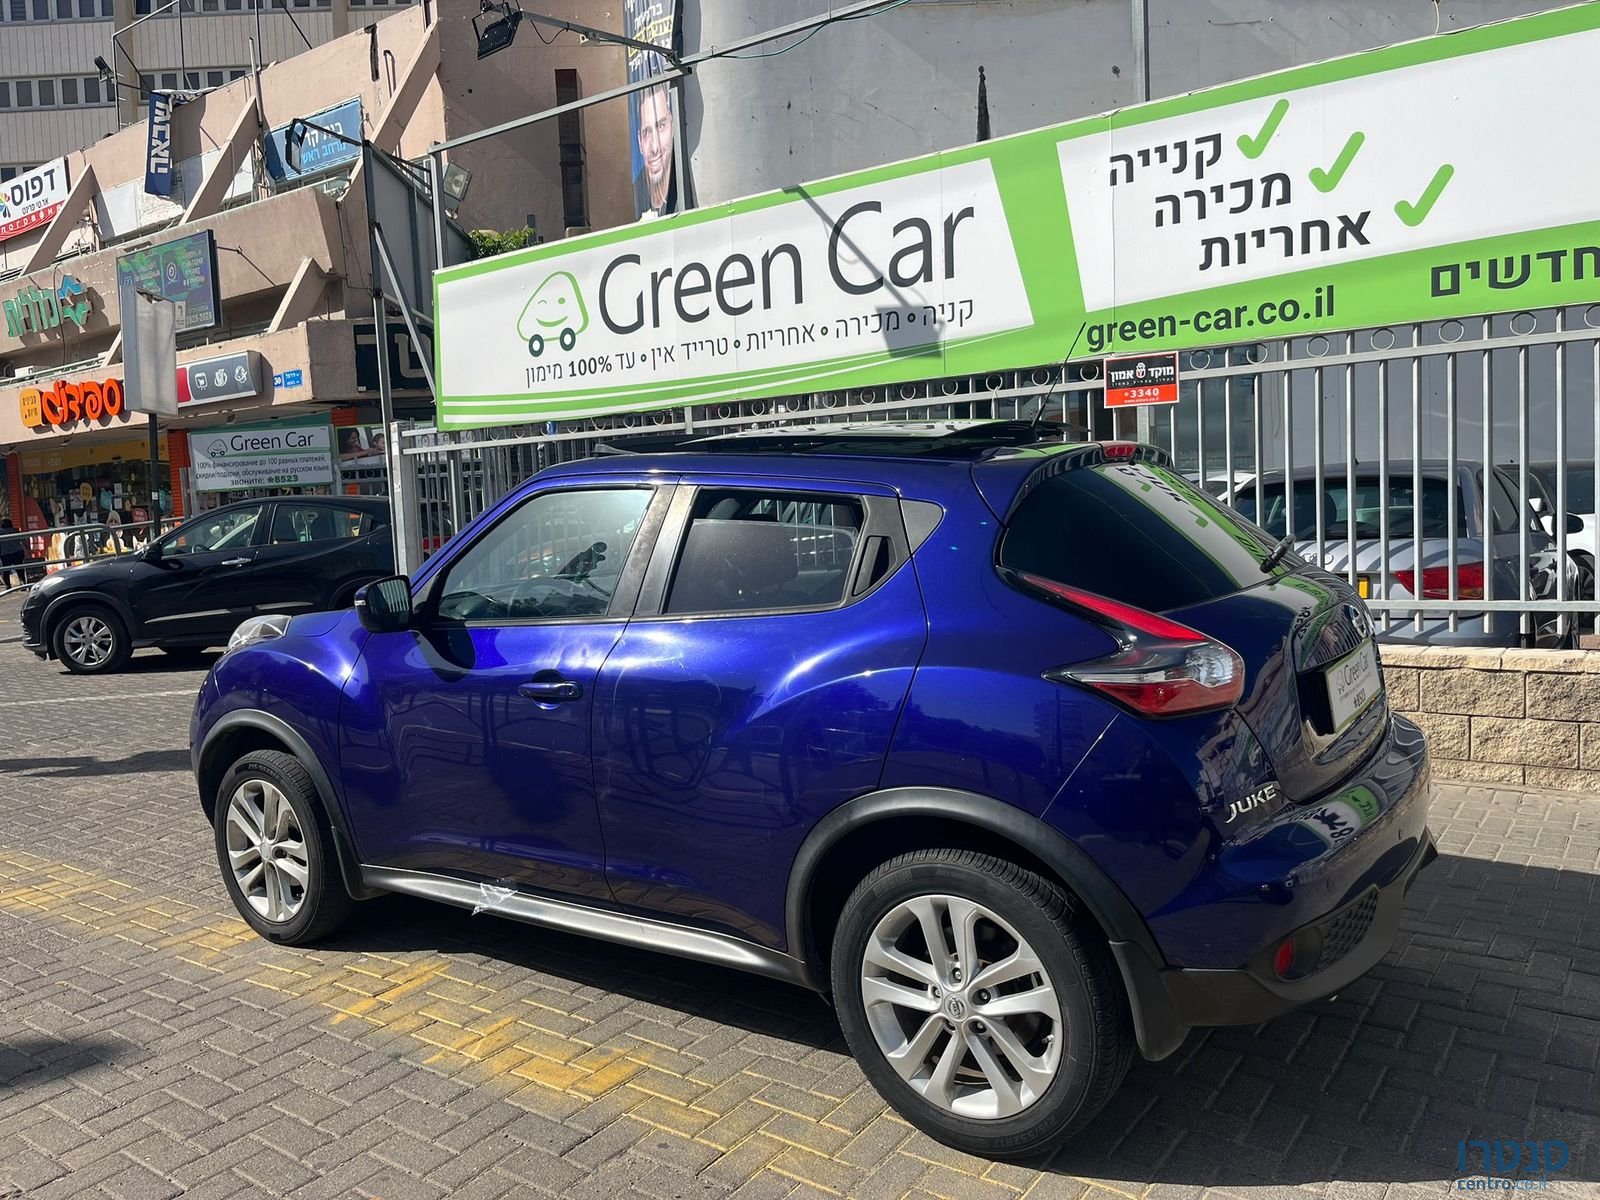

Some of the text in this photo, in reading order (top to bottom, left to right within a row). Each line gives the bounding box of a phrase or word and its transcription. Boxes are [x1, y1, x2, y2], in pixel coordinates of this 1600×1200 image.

[10, 168, 55, 206] דפוס
[1109, 133, 1222, 187] קנייה
[1155, 172, 1291, 228] מכירה
[1199, 210, 1371, 271] אחריות
[598, 200, 975, 336] Green Car
[525, 299, 974, 389] קניה מכירה אחריות טרייד אין עד 100% מימון
[1086, 285, 1335, 352] green-car.co.il
[1110, 366, 1175, 383] מוקד אמון
[230, 431, 314, 451] Green Car
[268, 457, 278, 466] 100
[1225, 783, 1277, 824] JUKE
